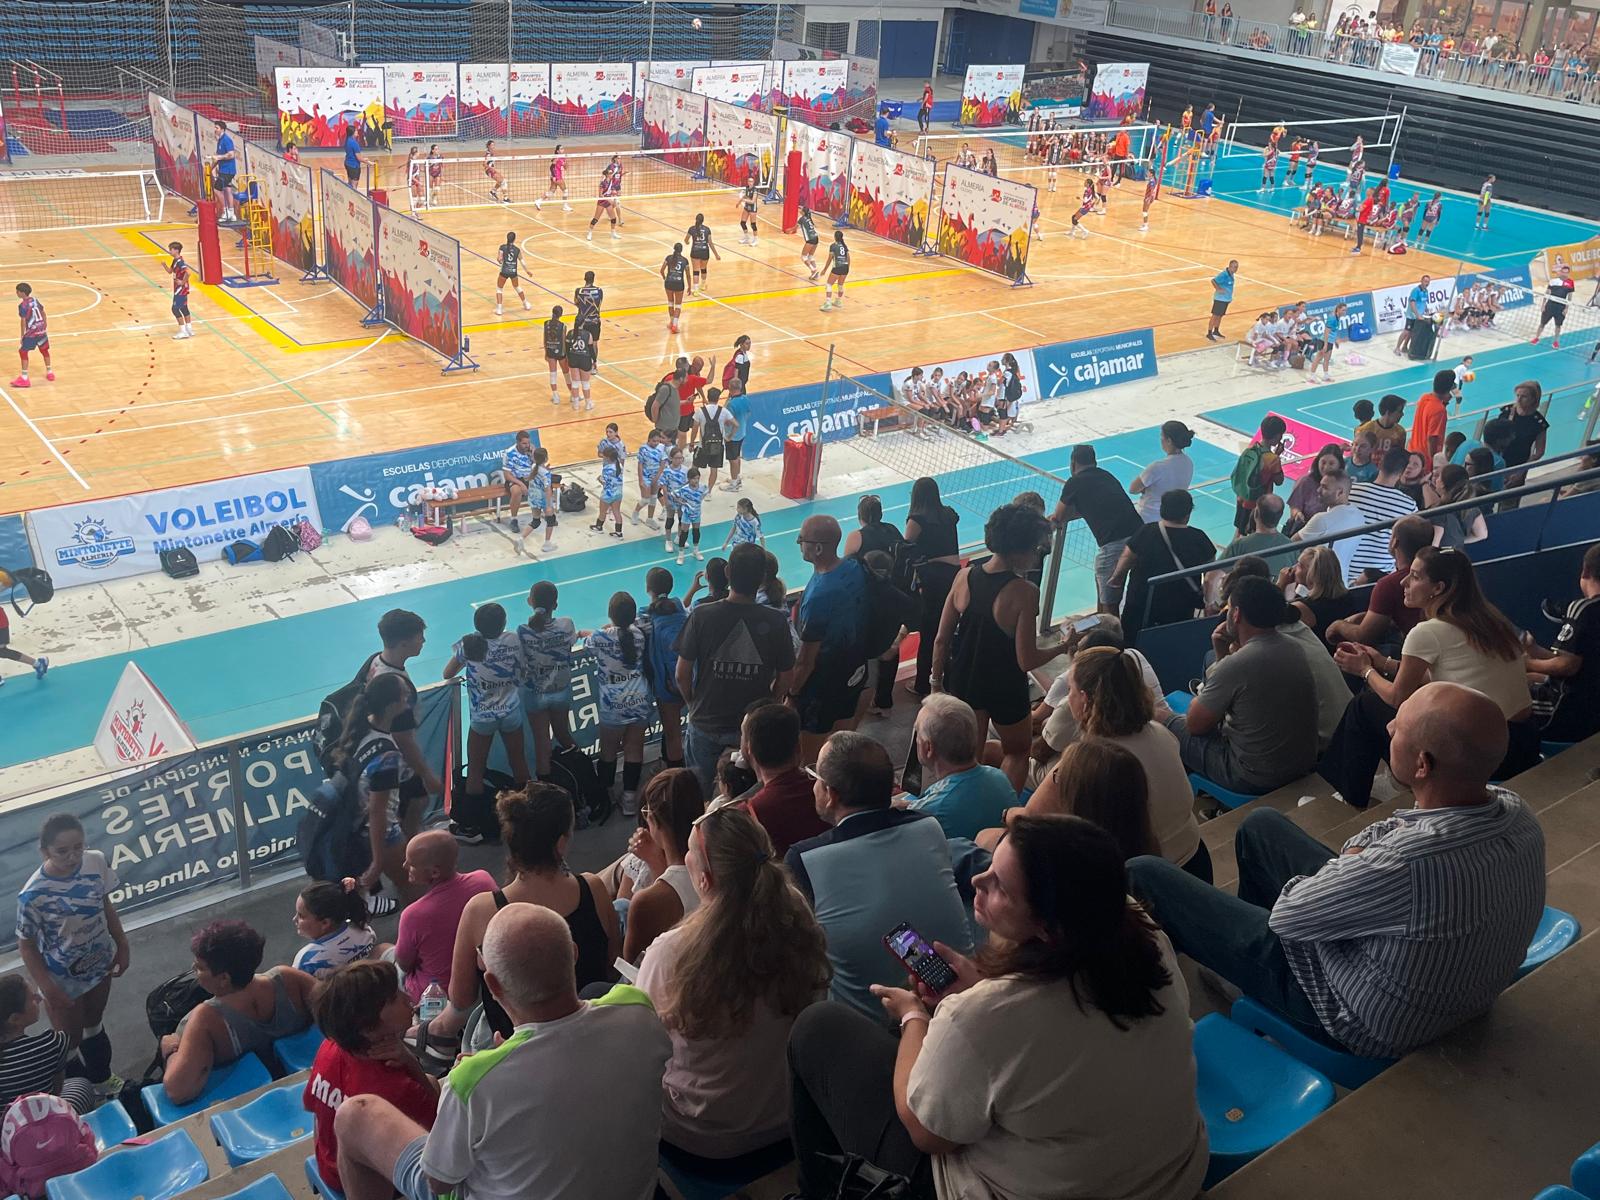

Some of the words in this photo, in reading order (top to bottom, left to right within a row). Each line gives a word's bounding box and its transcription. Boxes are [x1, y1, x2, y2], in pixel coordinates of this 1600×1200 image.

[840, 246, 846, 256] 8
[1570, 248, 1600, 262] VOLEIBO
[572, 339, 586, 350] 20
[1070, 350, 1092, 358] ESCUELAS
[1116, 340, 1142, 350] MUNICIPALES
[1074, 352, 1144, 385] cajamar
[782, 402, 812, 414] ESCUELAS
[383, 462, 430, 476] ESCUELAS
[432, 454, 482, 470] DEPORTIVAS
[482, 450, 508, 462] ALME
[389, 469, 506, 508] cajama
[145, 488, 306, 536] VOLEIBOL
[58, 536, 133, 560] MINTONETTE
[153, 525, 246, 554] Mintonette
[80, 551, 115, 562] ALMERIA
